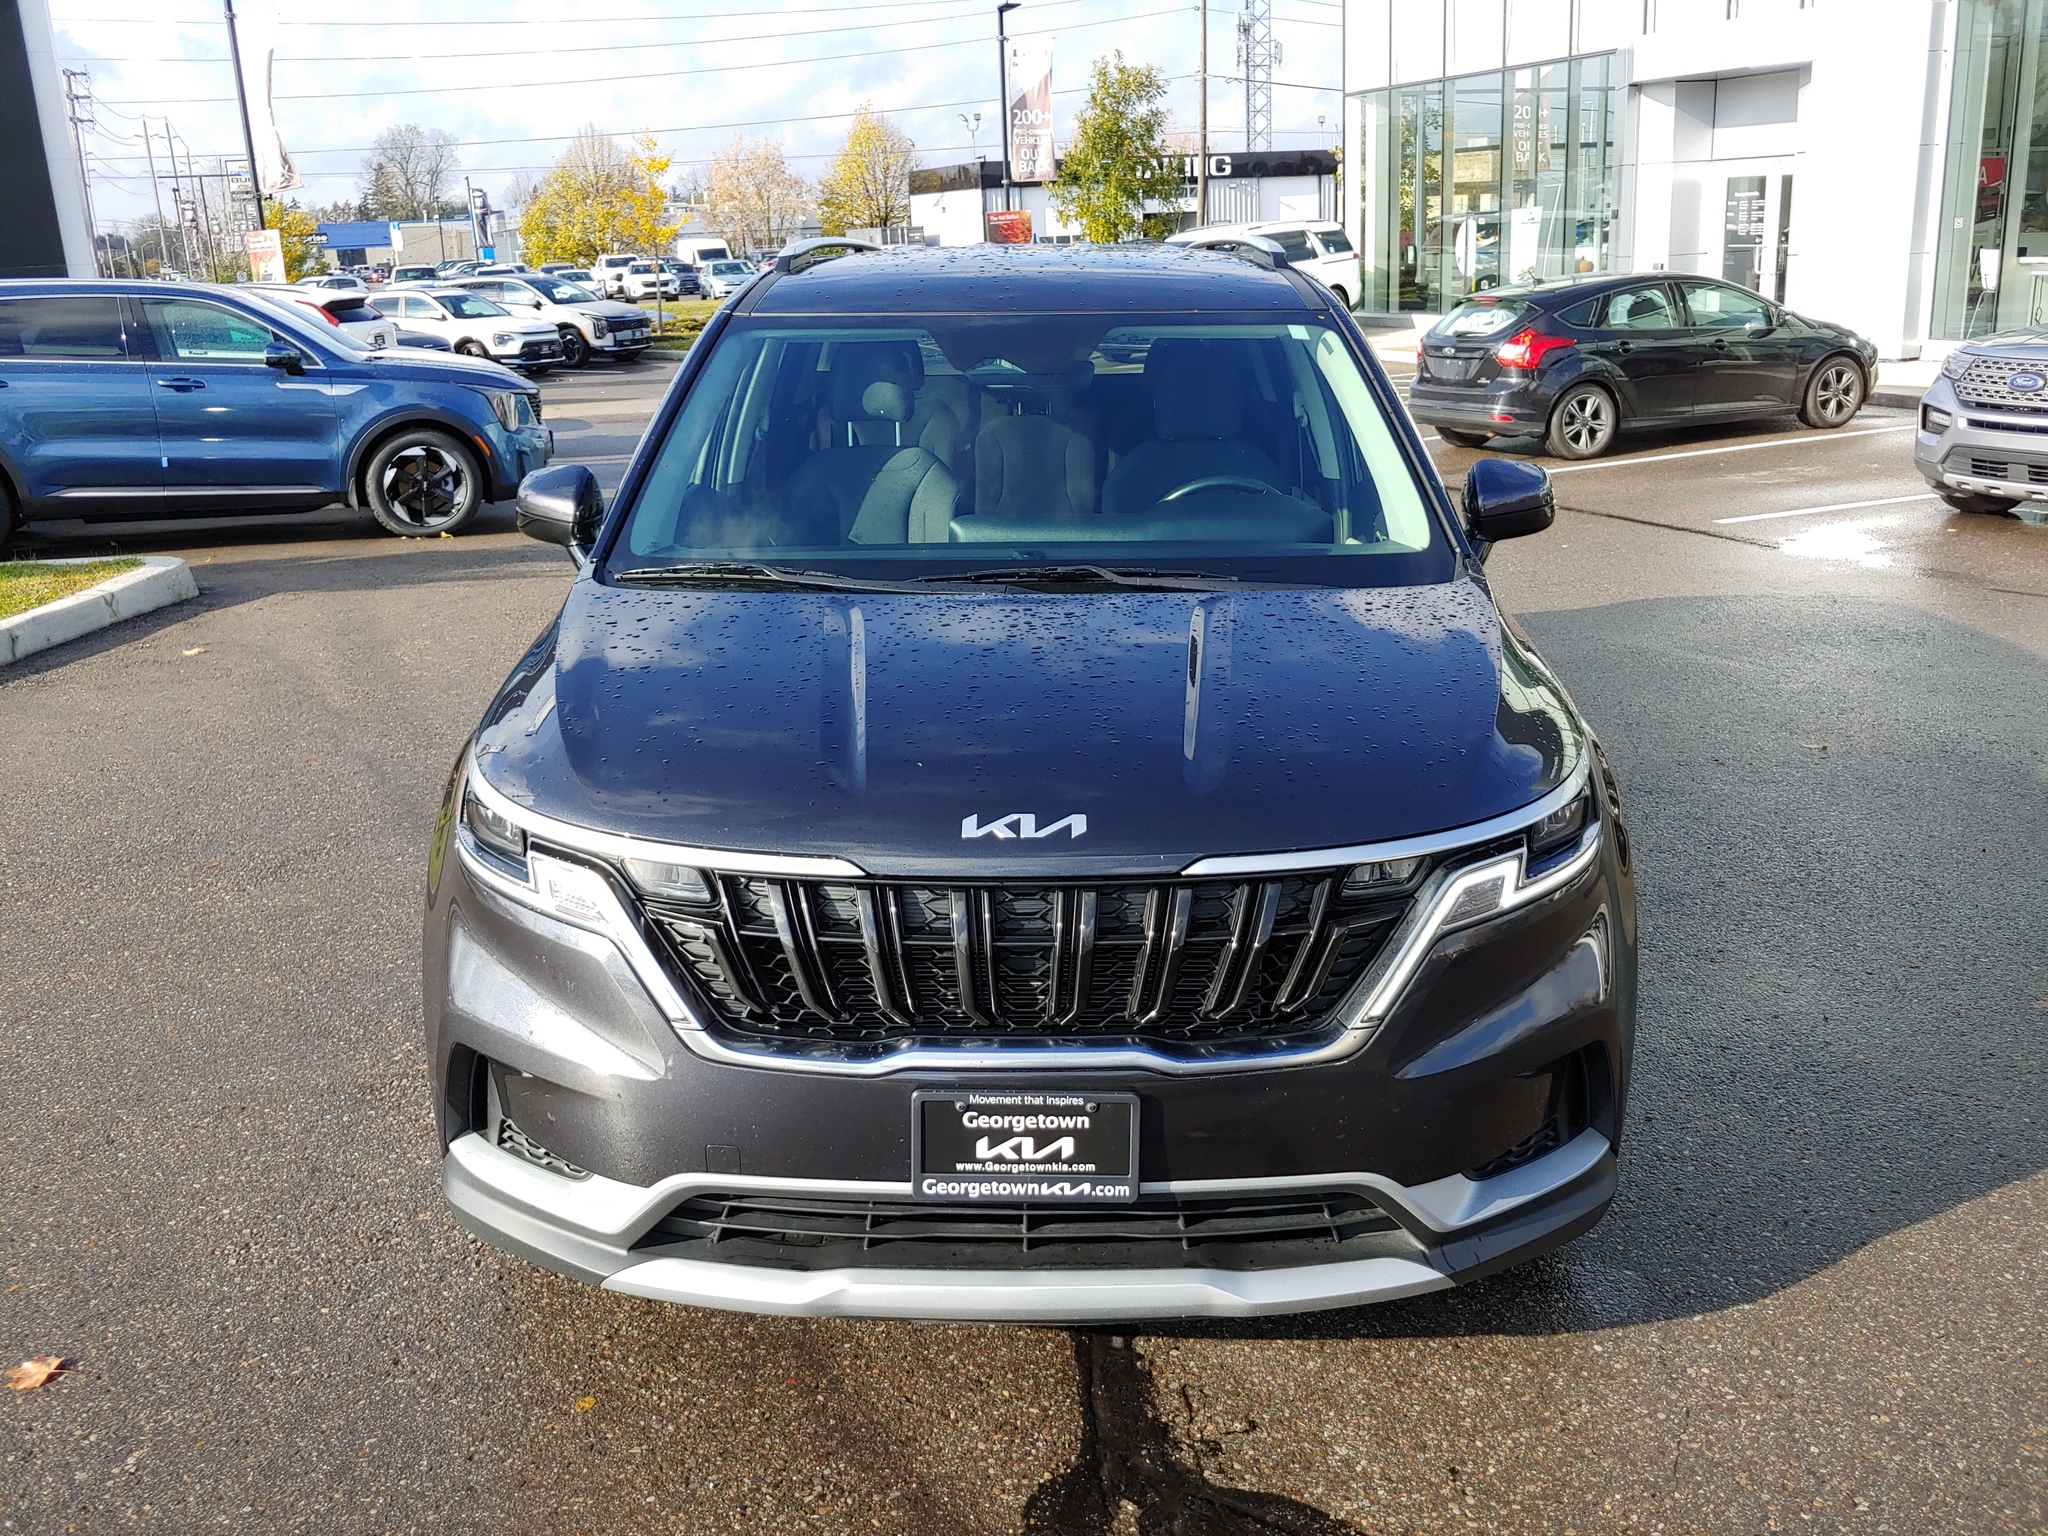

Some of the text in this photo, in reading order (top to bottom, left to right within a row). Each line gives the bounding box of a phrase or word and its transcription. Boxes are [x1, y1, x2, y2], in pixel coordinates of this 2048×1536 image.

[1013, 109, 1051, 125] 200+
[1514, 105, 1549, 119] 20+
[1515, 151, 1547, 162] BAK
[961, 813, 1087, 838] KIA
[969, 1094, 1084, 1107] Movement that inspires
[962, 1111, 1090, 1132] Georgetown
[975, 1135, 1075, 1159] KIA
